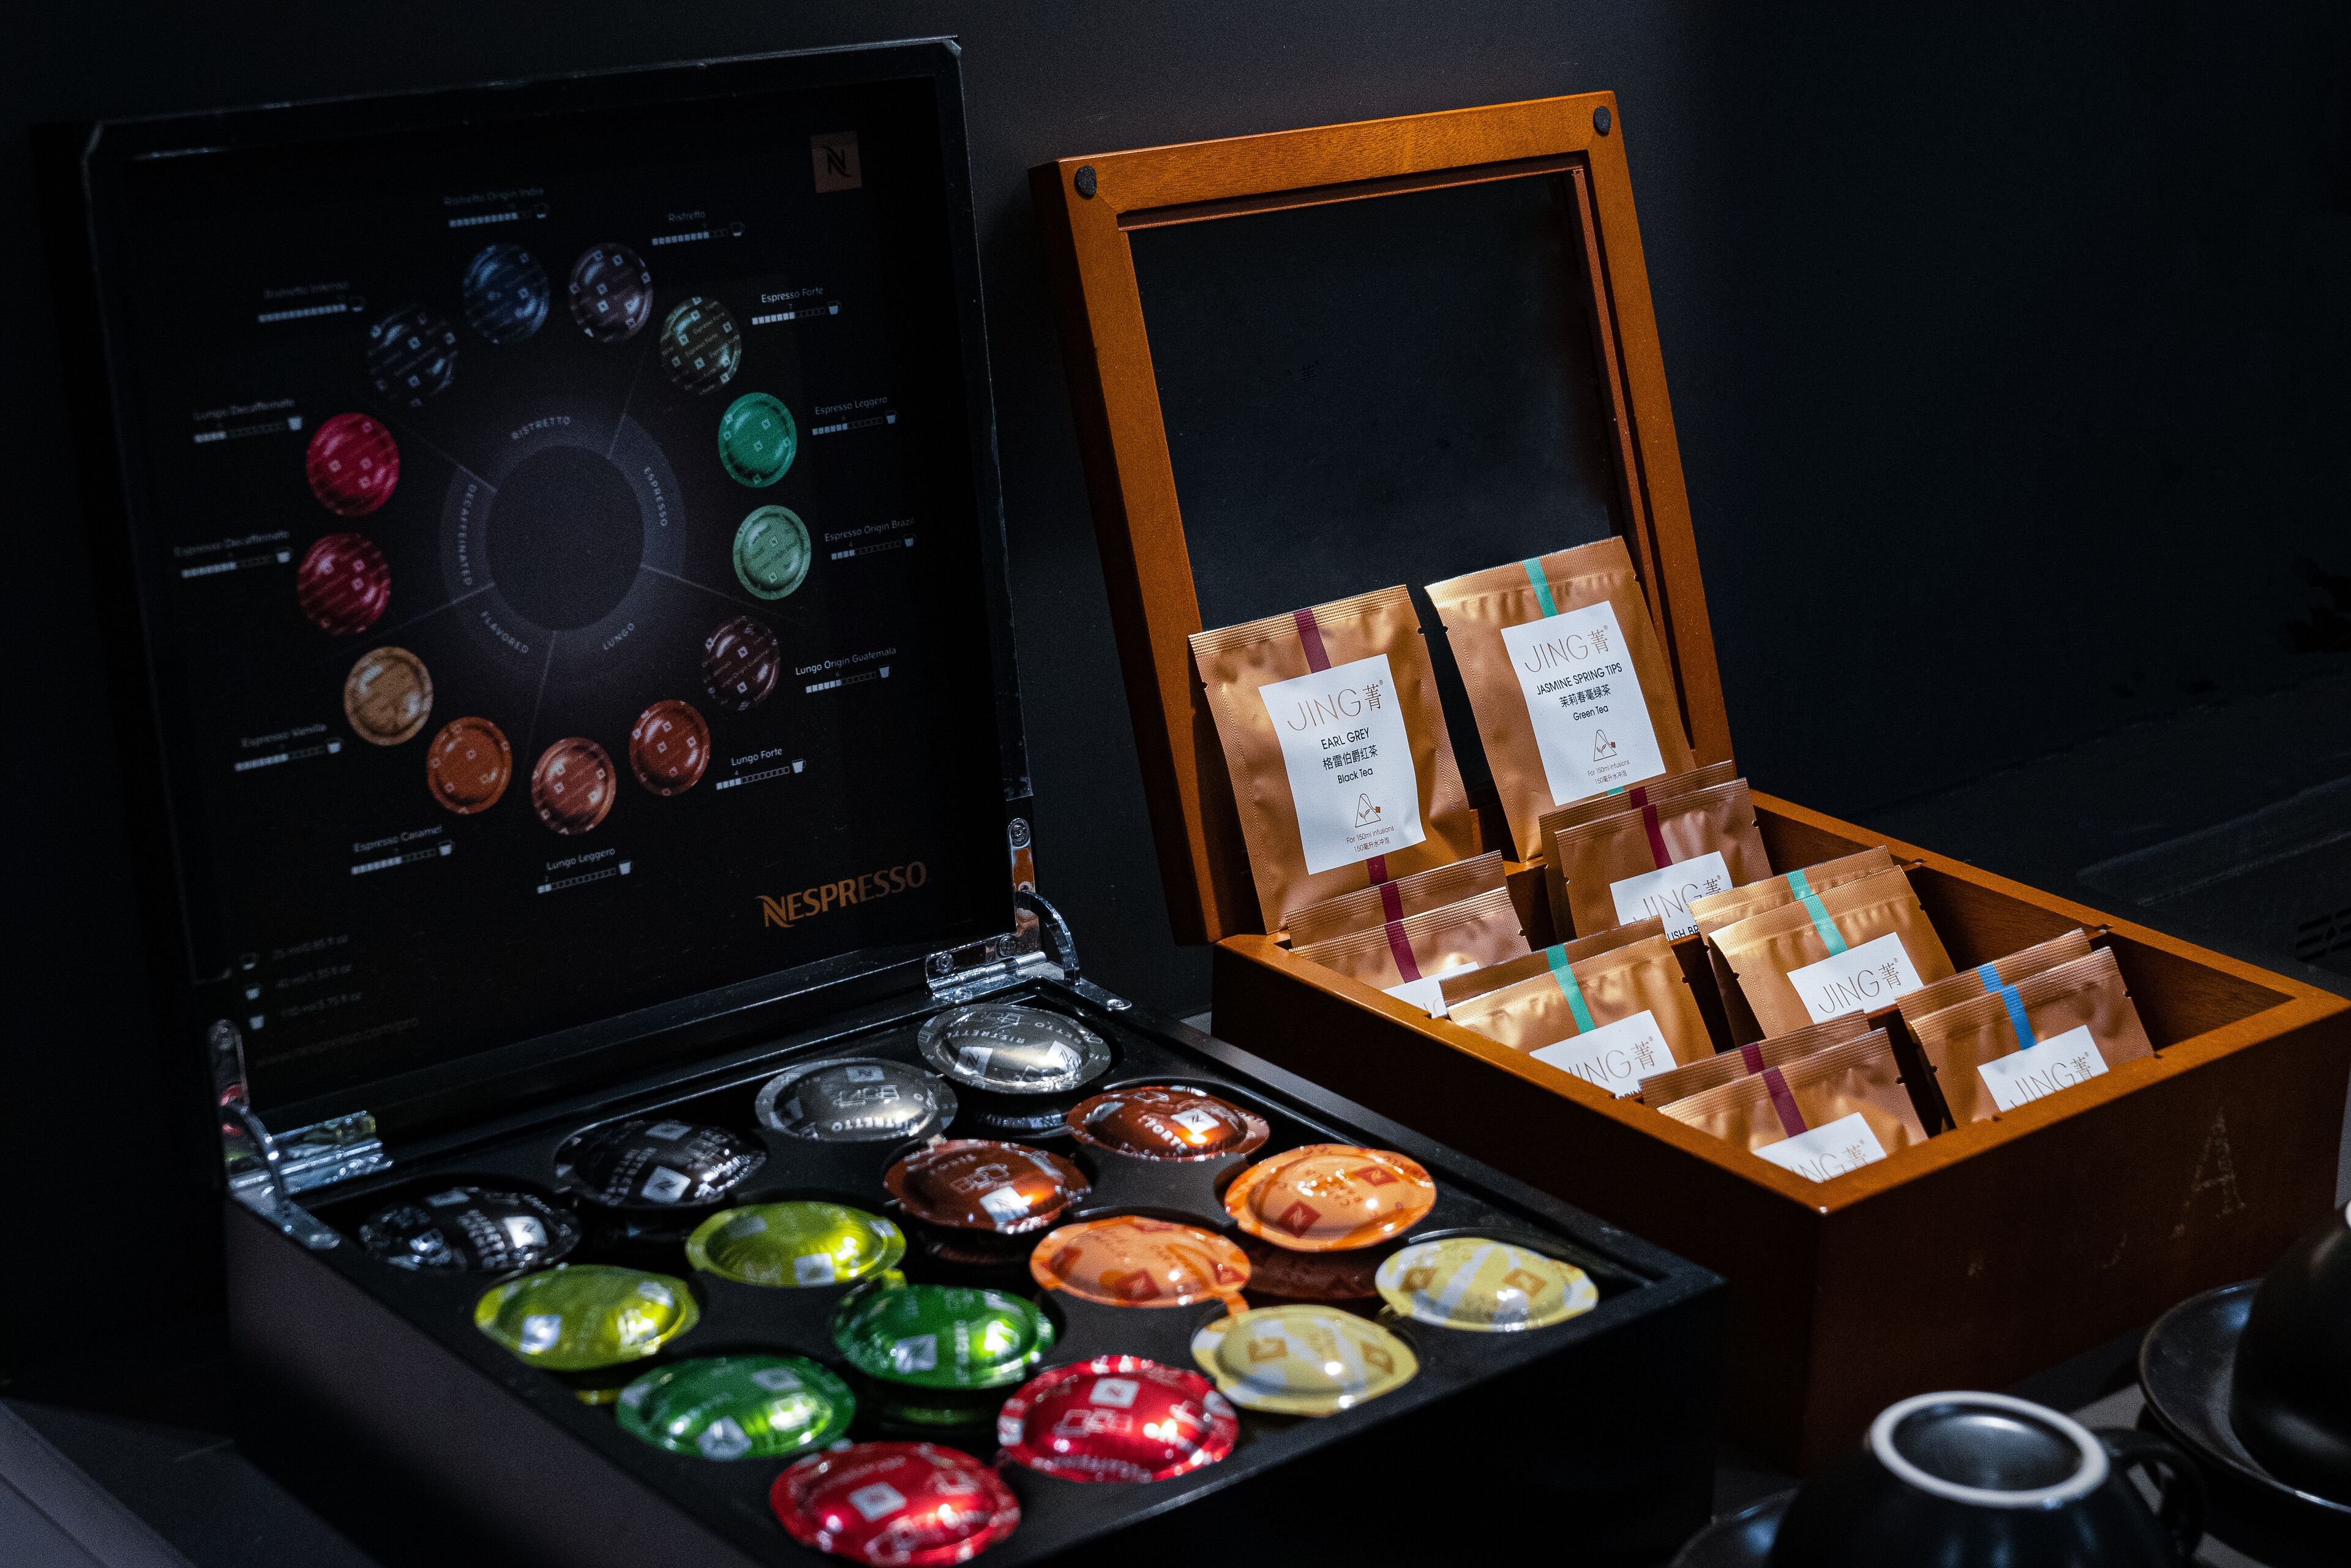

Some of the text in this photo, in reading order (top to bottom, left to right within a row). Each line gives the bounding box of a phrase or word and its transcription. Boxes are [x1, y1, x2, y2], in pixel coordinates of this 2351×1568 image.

[761, 287, 823, 304] Espresso Forte
[814, 397, 888, 416] Espresso Leggero
[511, 416, 570, 440] RISTRETTO
[643, 466, 668, 527] ESPRESSO
[824, 517, 915, 542] Espresso Origin Brazil
[481, 611, 529, 654] FLAVORED
[602, 622, 636, 651] LUNGO
[796, 647, 897, 675] Lungo Origin Guatemala
[1524, 634, 1588, 673] JING
[1536, 662, 1622, 695] JASMINE SPRING TIPS
[1559, 684, 1611, 708] 茉莉春毫绿茶
[1287, 689, 1361, 731] JING
[1573, 705, 1609, 721] Green Tea
[1321, 727, 1370, 749] EARL GREY
[731, 748, 783, 766] Lungo Forte
[1322, 745, 1378, 770] 格雷伯爵红茶
[1610, 760, 1630, 771] infusions
[1337, 768, 1373, 784] Black Tea
[1356, 831, 1371, 841] 150ml
[1371, 825, 1395, 836] infusions
[546, 847, 616, 871] Lungo Leggero
[754, 861, 927, 928] NESPRESSO
[1818, 970, 1880, 1013] JING
